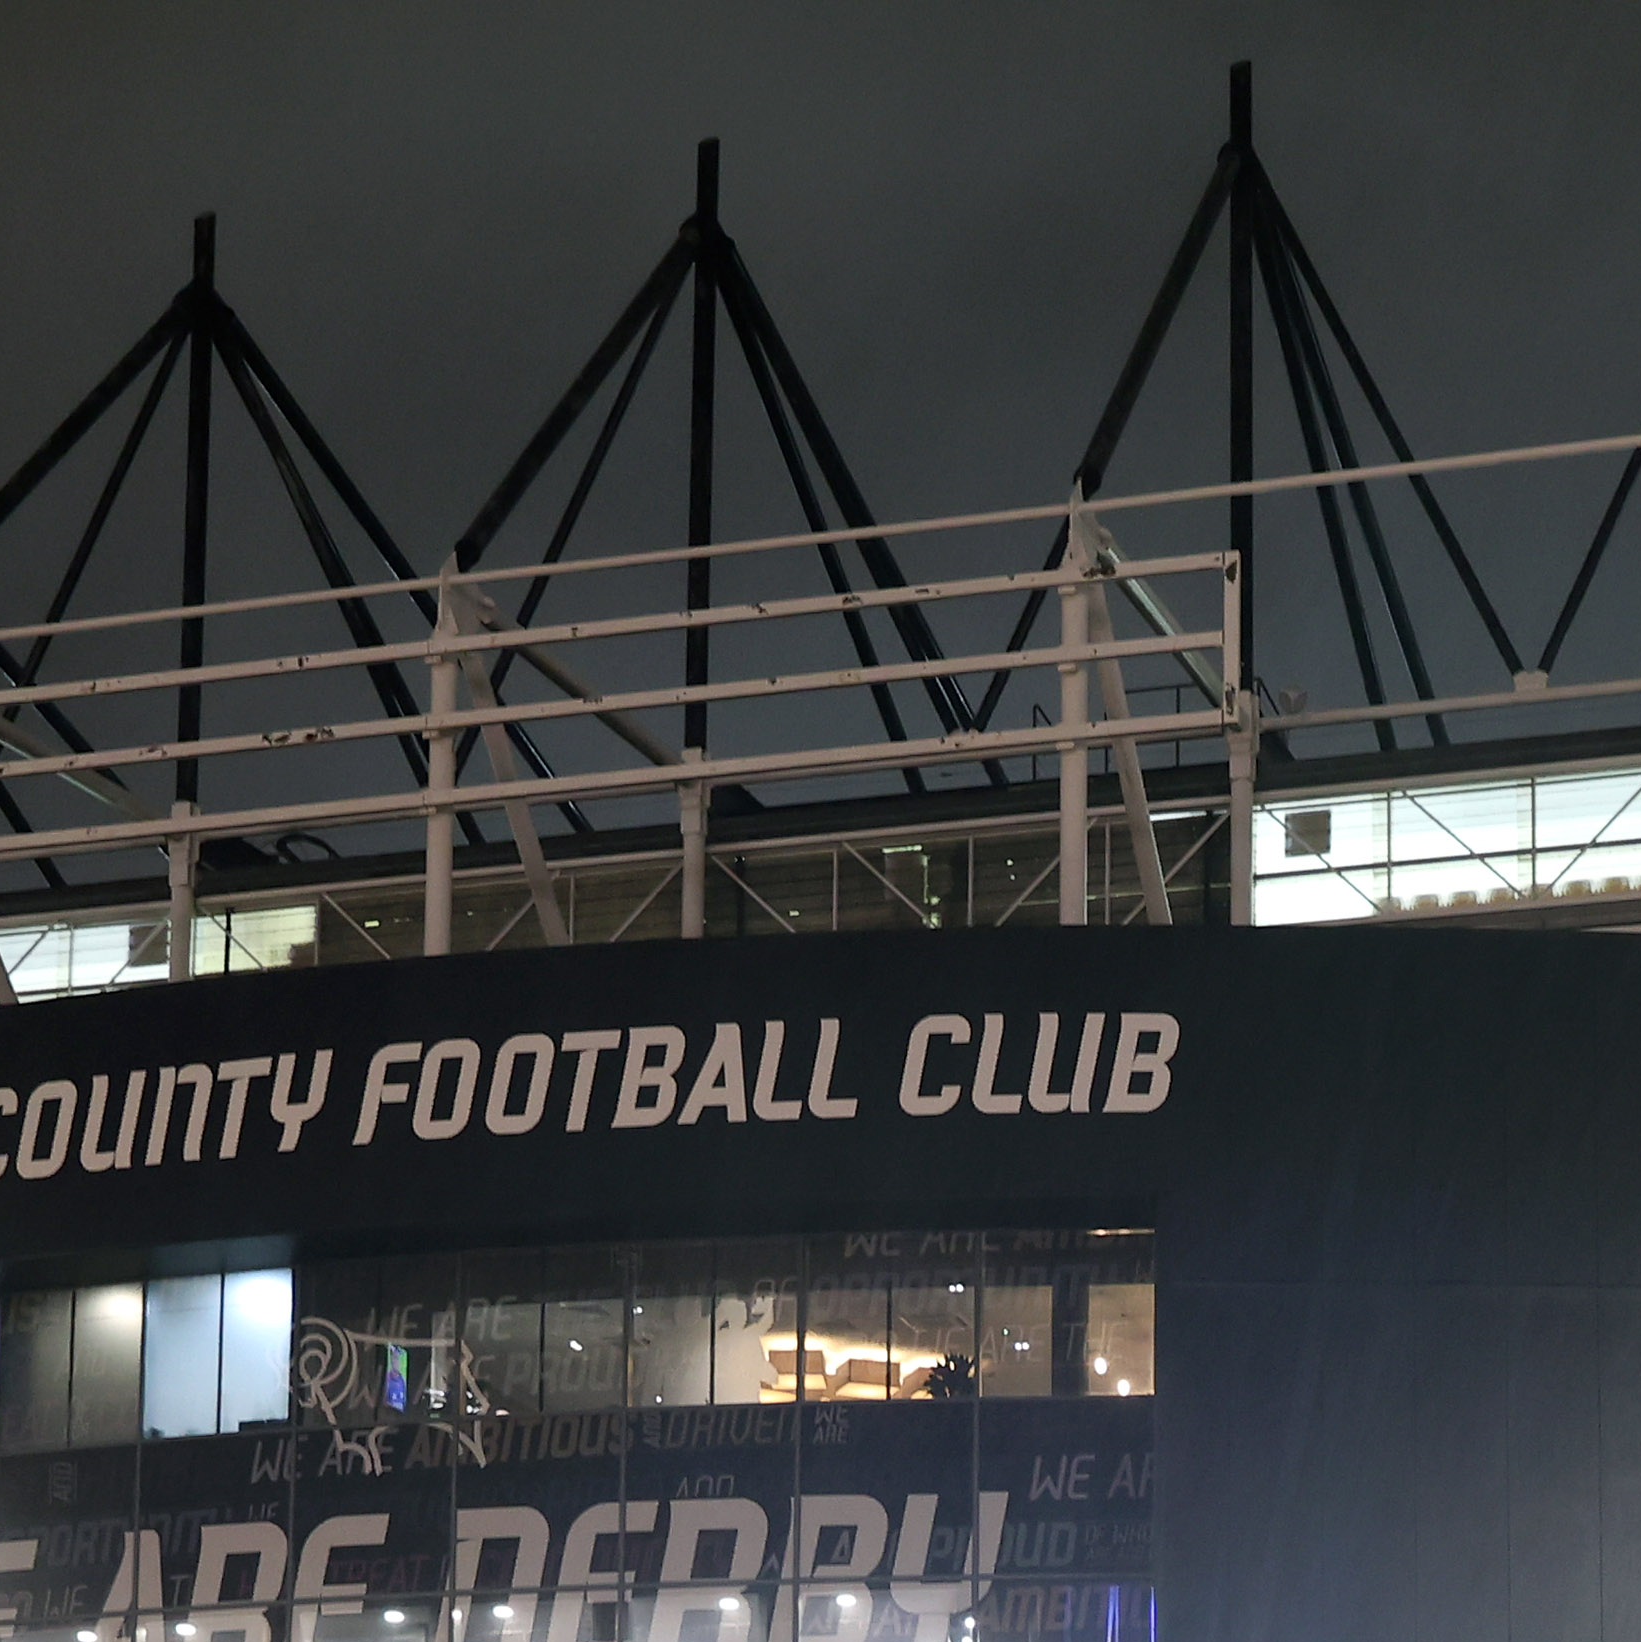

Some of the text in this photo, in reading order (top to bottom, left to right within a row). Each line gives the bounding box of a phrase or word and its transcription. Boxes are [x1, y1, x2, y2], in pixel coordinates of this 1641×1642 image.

[353, 1018, 859, 1146] FOOTBALL
[898, 1012, 1180, 1118] CLUB
[814, 1405, 850, 1425] WE
[250, 1435, 307, 1485] WE
[318, 1426, 399, 1478] ARE
[1029, 1453, 1096, 1501] WE
